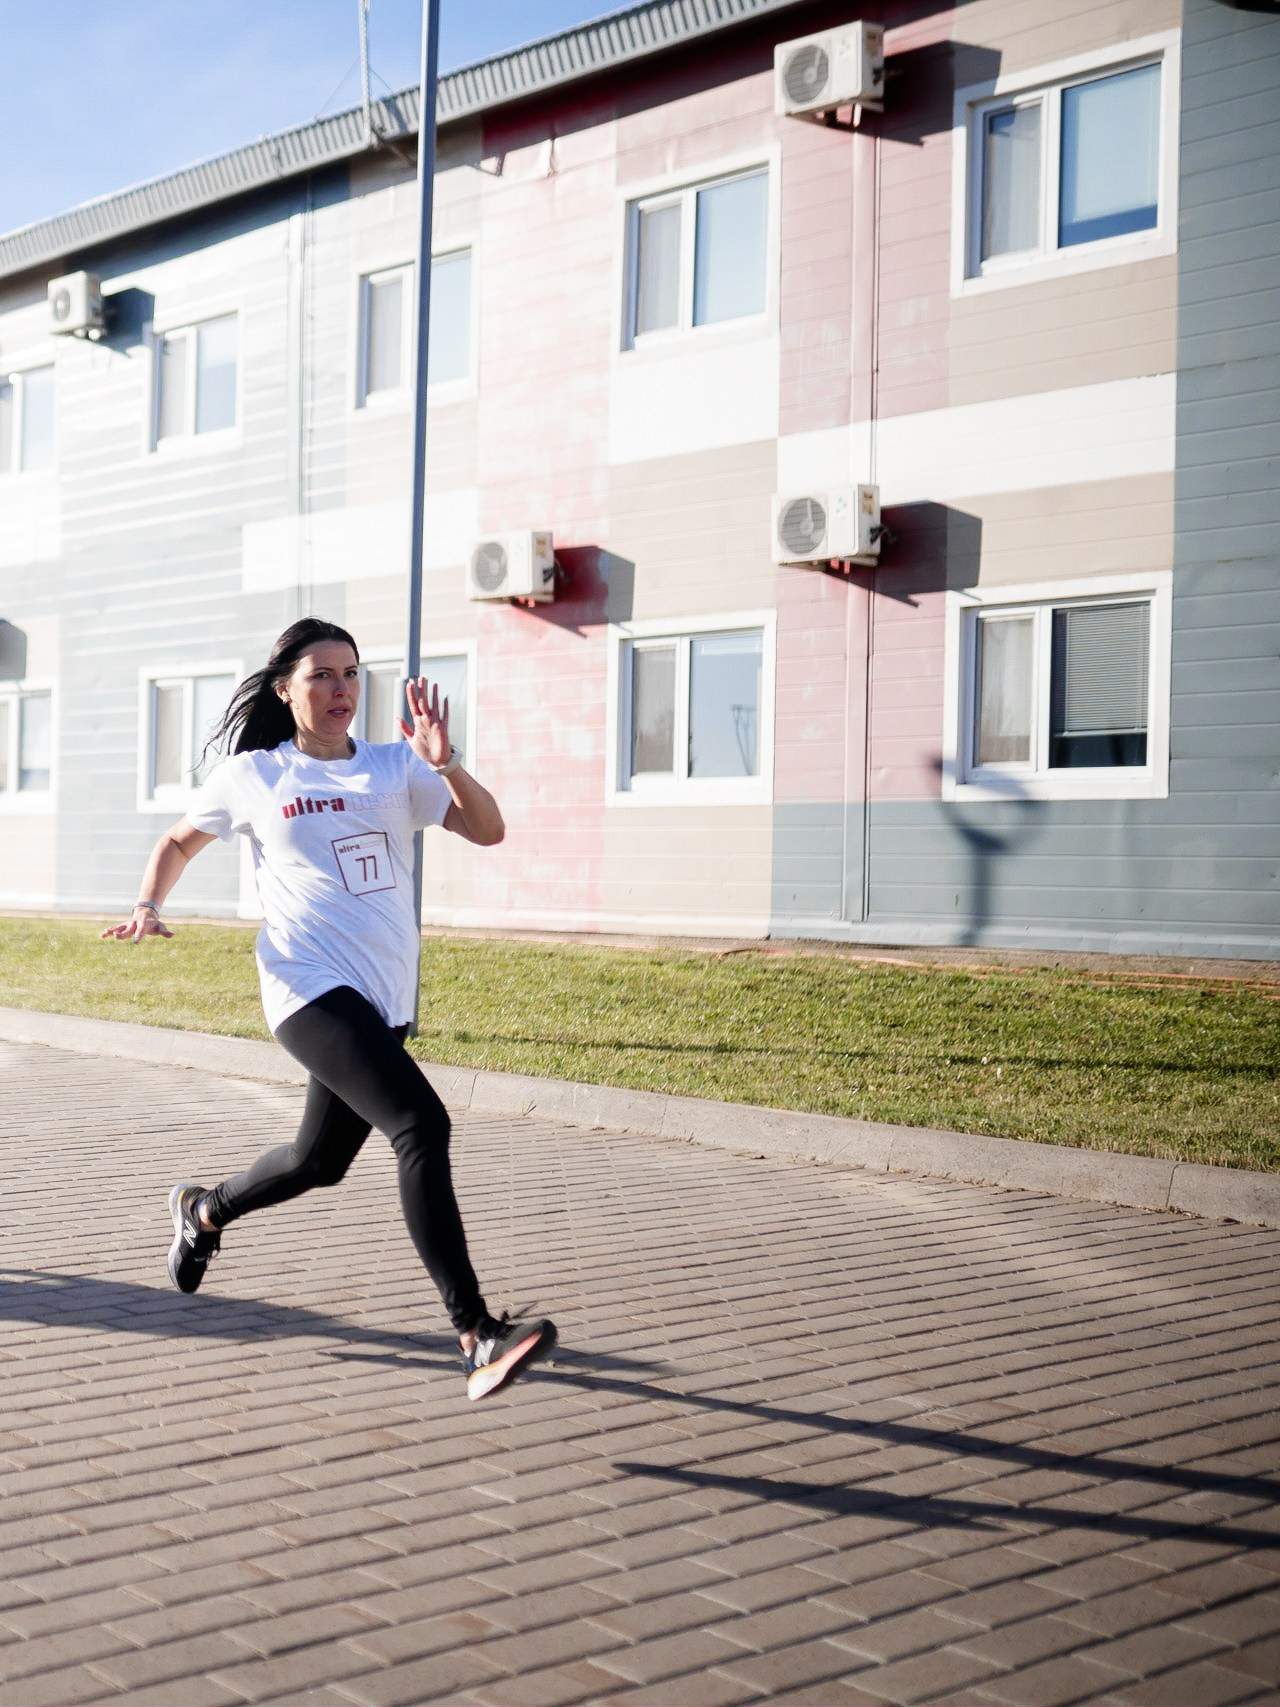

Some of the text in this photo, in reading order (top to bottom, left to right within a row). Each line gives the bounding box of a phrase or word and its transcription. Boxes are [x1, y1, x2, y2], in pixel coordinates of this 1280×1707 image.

[282, 796, 345, 819] ultra
[338, 844, 361, 854] ultra
[355, 855, 378, 882] 77
